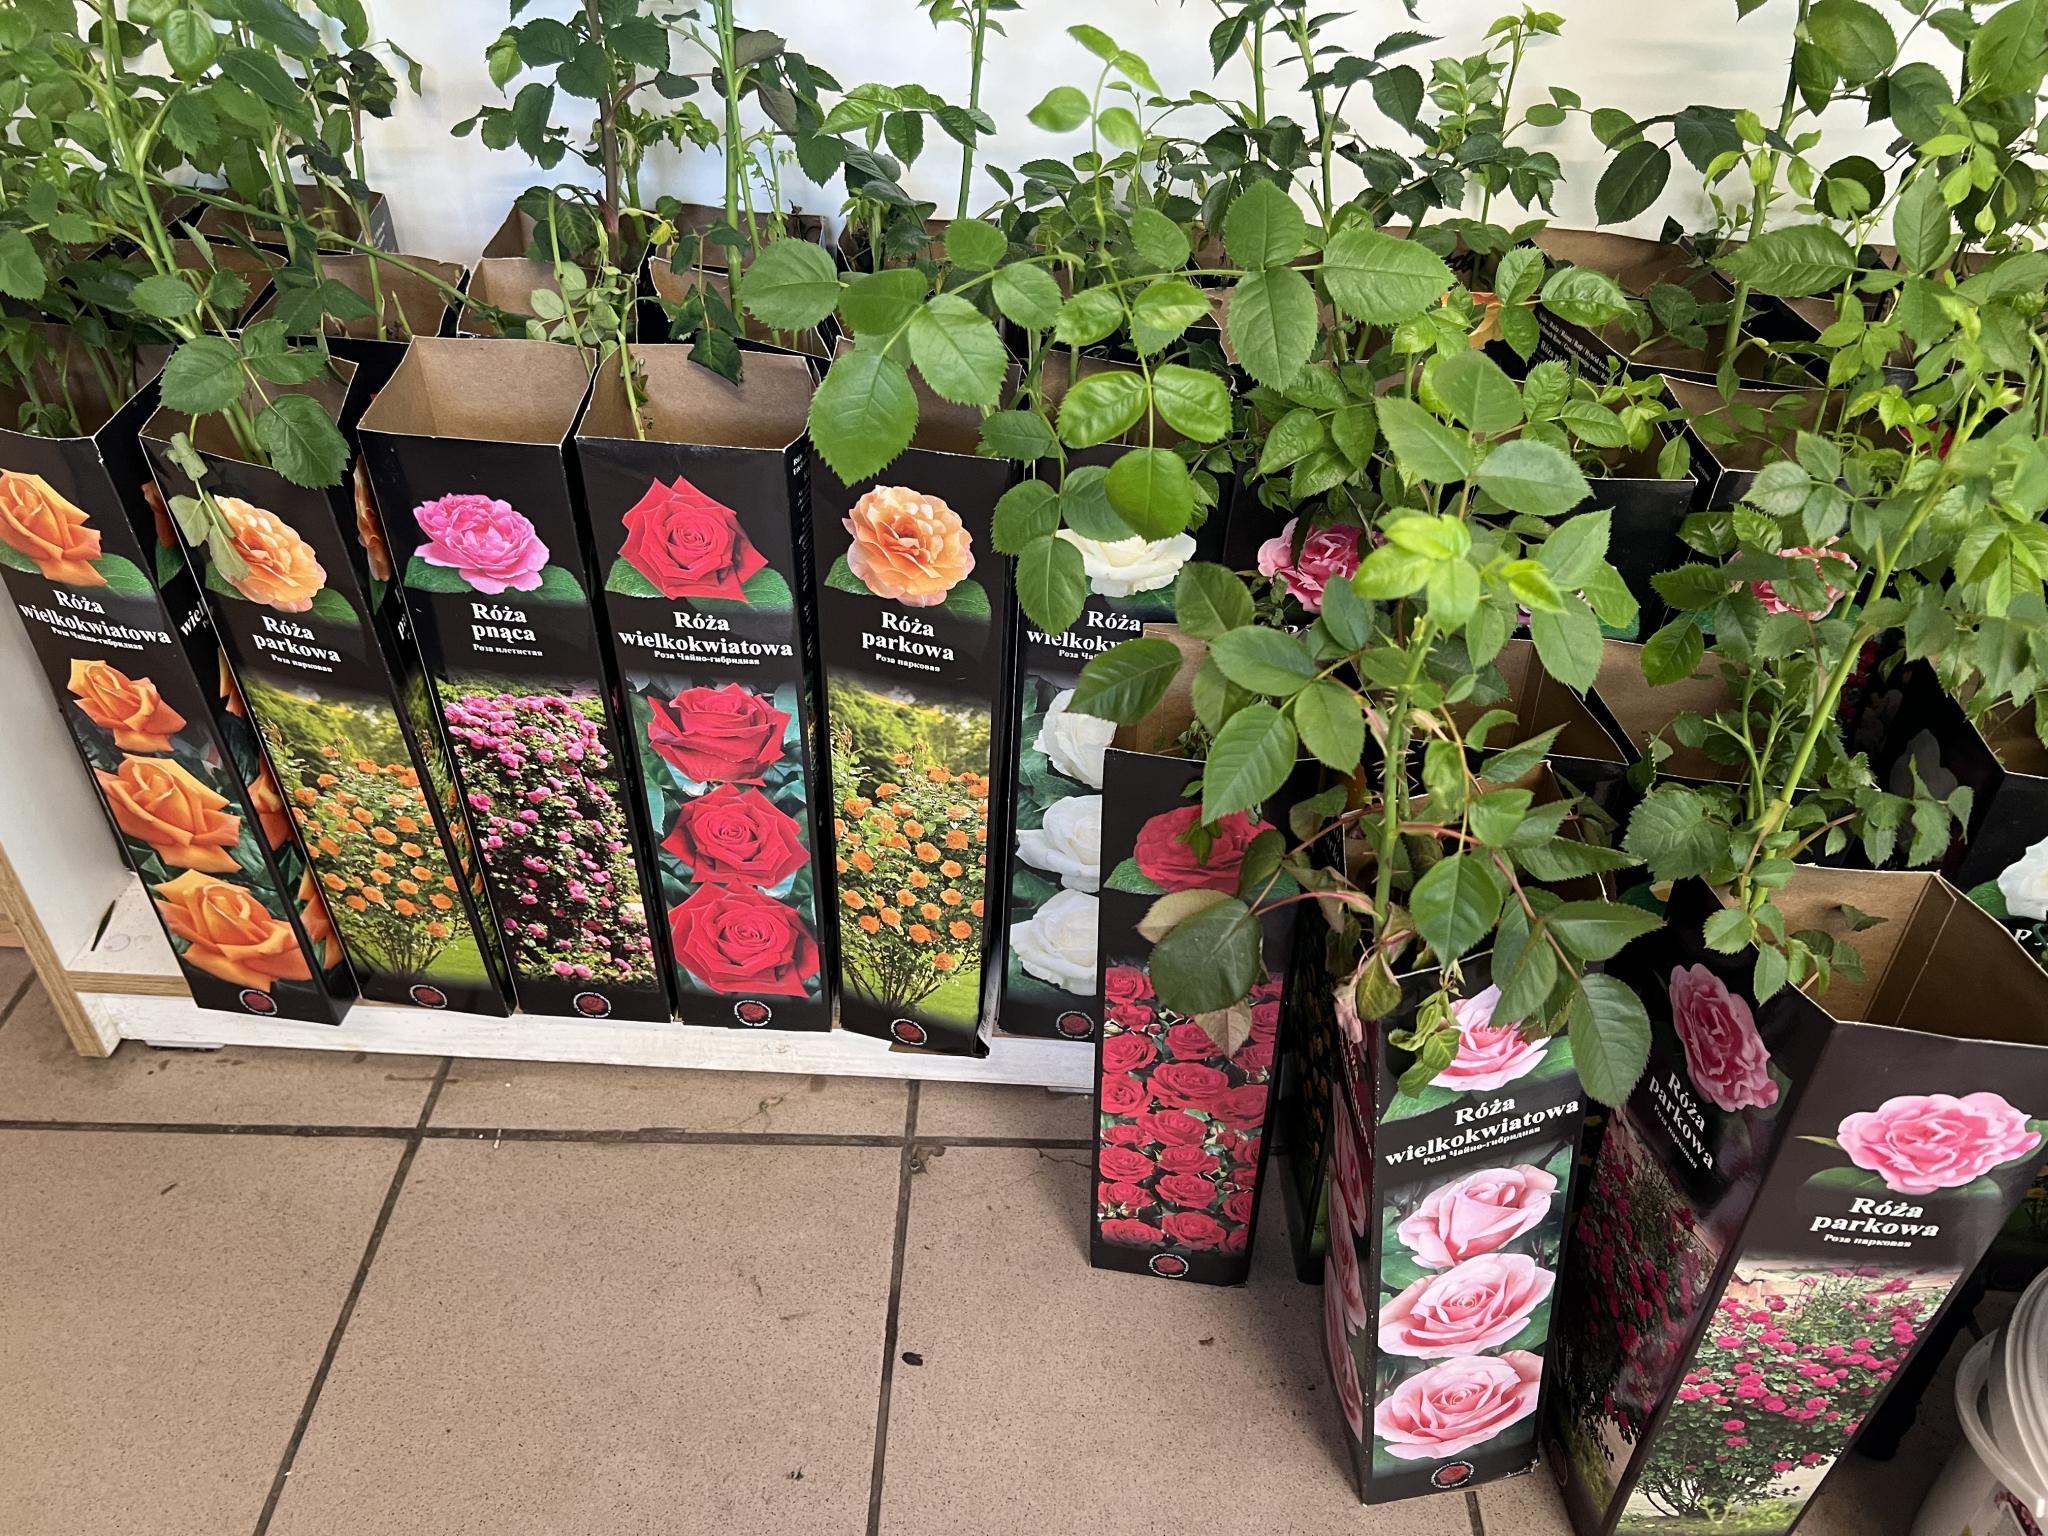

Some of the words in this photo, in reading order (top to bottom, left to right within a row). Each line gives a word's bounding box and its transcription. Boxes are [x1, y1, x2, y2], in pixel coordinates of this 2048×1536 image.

[53, 589, 105, 614] Róża
[470, 602, 527, 623] Róża
[19, 604, 172, 645] wielkokwiatowa
[261, 615, 315, 641] Róża
[471, 624, 536, 643] pnąca
[673, 611, 730, 631] Róża
[881, 610, 934, 637] Róża
[1086, 610, 1141, 632] Róża
[252, 633, 341, 663] parkowa
[618, 631, 793, 656] wielkokwiatowa
[654, 650, 675, 660] Роза
[862, 631, 954, 661] parkowa
[875, 653, 895, 665] Роза
[1454, 1097, 1516, 1126] Róża
[1667, 1072, 1705, 1133] Róża
[1385, 1100, 1579, 1166] wielkokwiatowa
[1649, 1076, 1714, 1170] parkowa
[1848, 1198, 1924, 1218] Róża
[1809, 1215, 1940, 1238] parkowa
